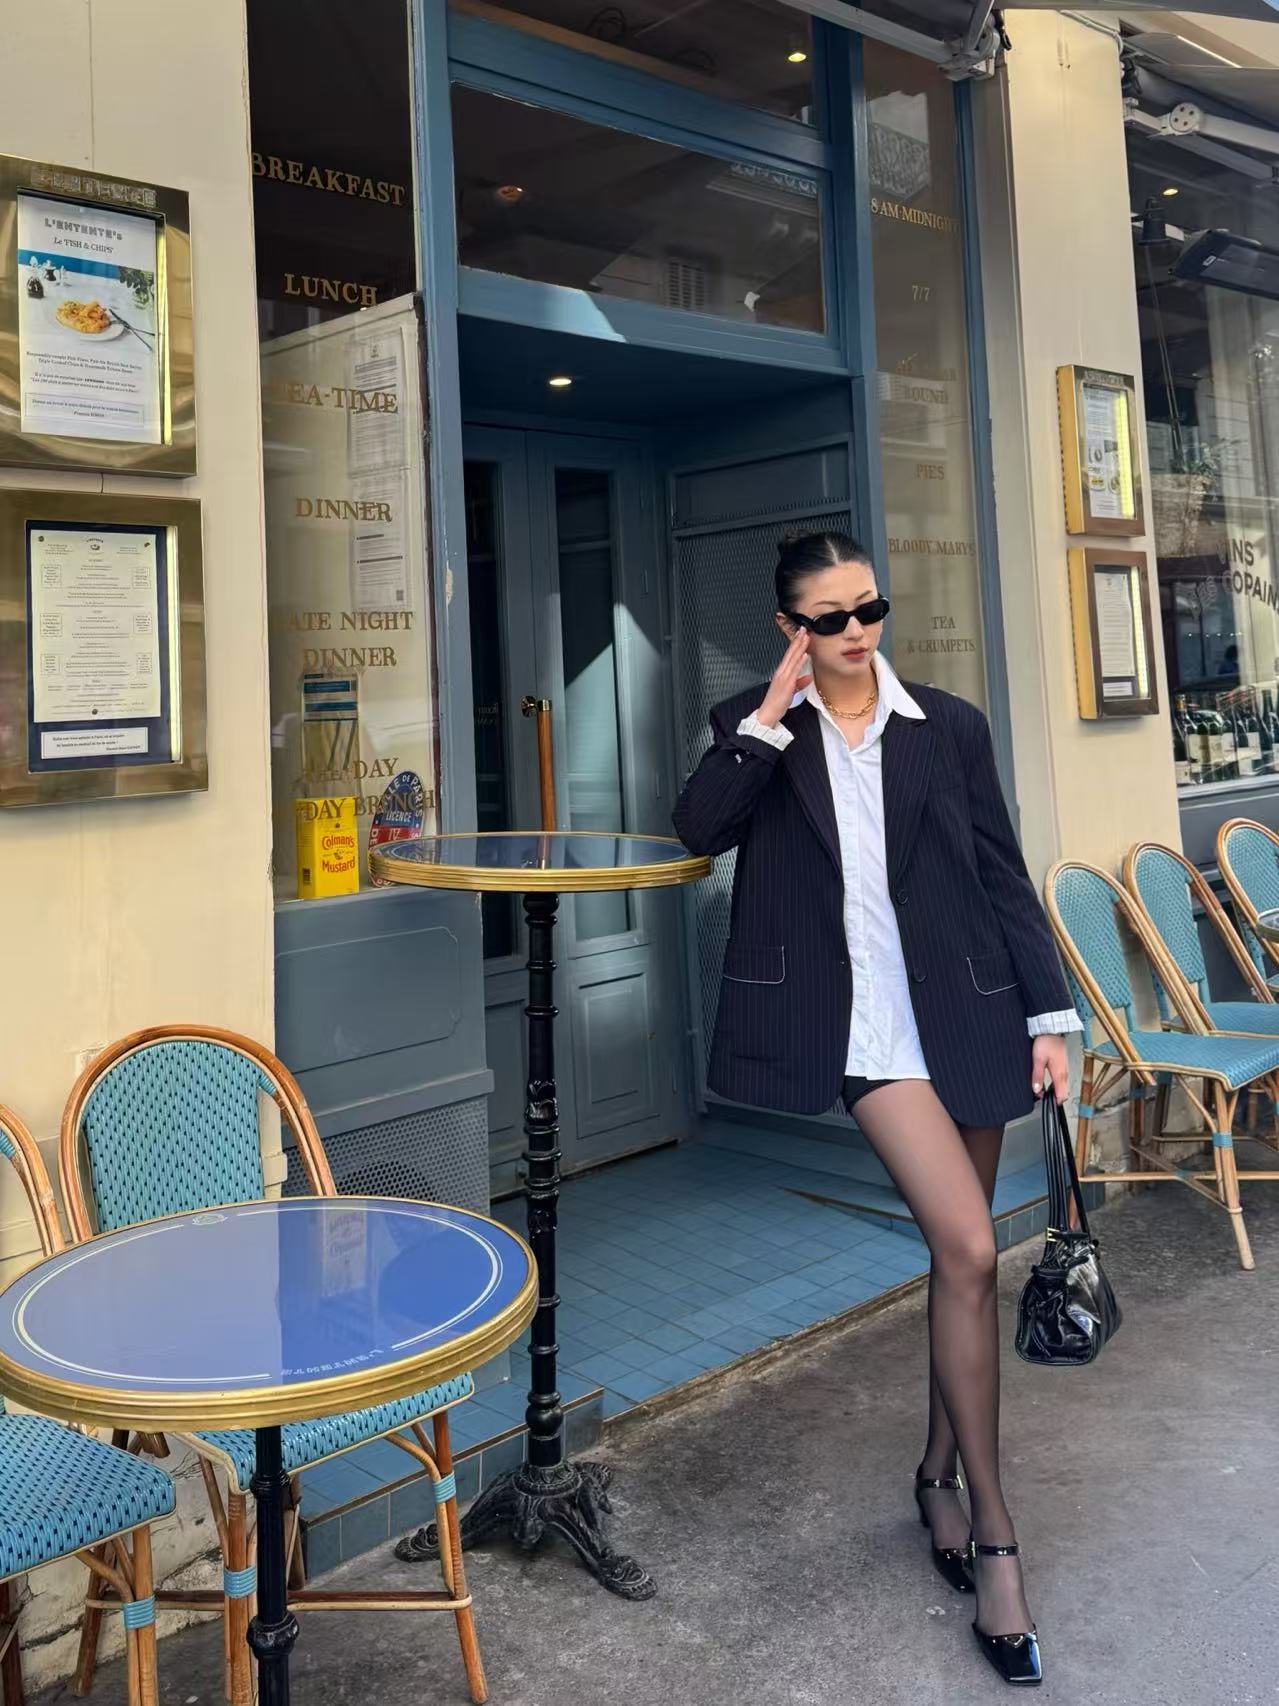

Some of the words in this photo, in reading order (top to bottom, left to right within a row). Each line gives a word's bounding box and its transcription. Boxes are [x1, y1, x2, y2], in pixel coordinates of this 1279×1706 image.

[251, 152, 405, 206] BREAKFAST
[284, 273, 377, 306] LUNCH
[912, 285, 930, 301] 7/7
[282, 384, 398, 413] EA-TIME
[916, 464, 945, 480] PIES
[295, 498, 393, 522] DINNER
[888, 538, 932, 554] BLOODY
[282, 611, 332, 631] ATE
[340, 611, 414, 631] NIGHT
[931, 616, 956, 630] TEA
[918, 638, 976, 653] CRUMPETS
[302, 646, 397, 669] DINNER
[386, 811, 413, 823] LICENCE
[321, 834, 355, 850] Colman's
[321, 855, 356, 873] Mustard
